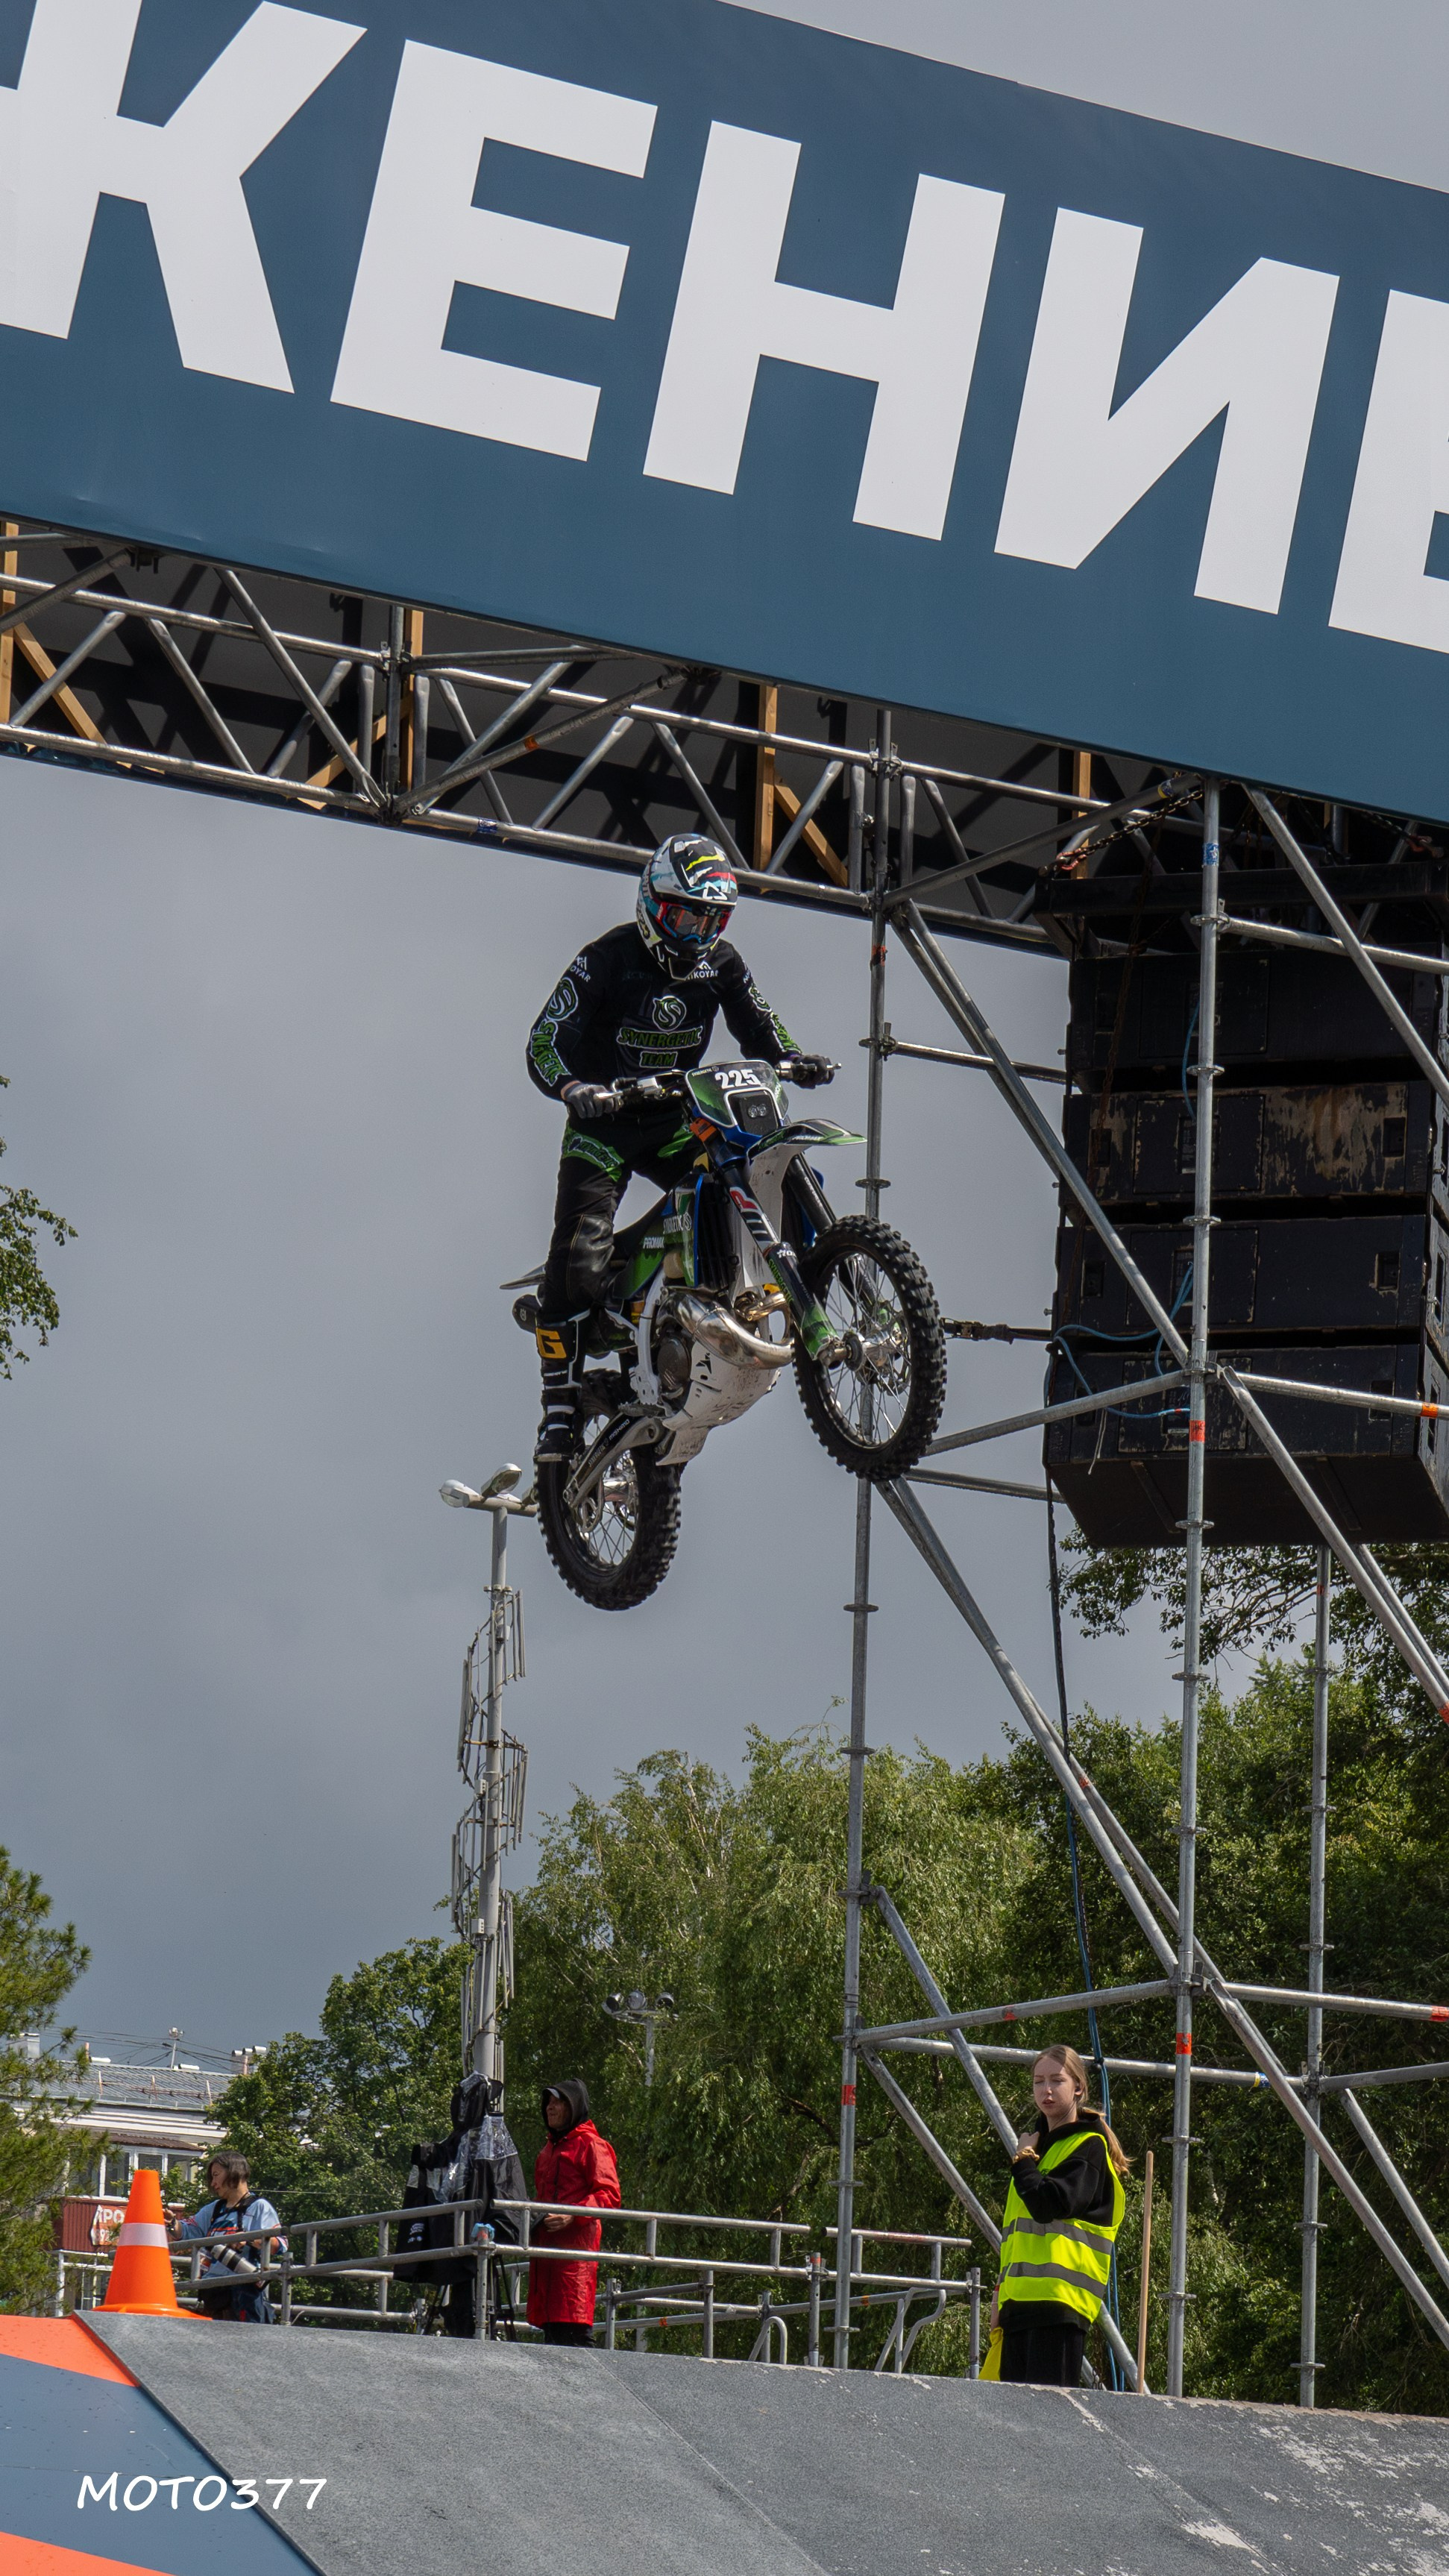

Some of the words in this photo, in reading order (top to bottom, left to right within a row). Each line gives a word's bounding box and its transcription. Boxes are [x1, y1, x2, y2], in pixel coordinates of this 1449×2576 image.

[617, 1027, 703, 1049] SYNERGETIC
[640, 1052, 678, 1068] TEAM
[714, 1069, 761, 1090] 225
